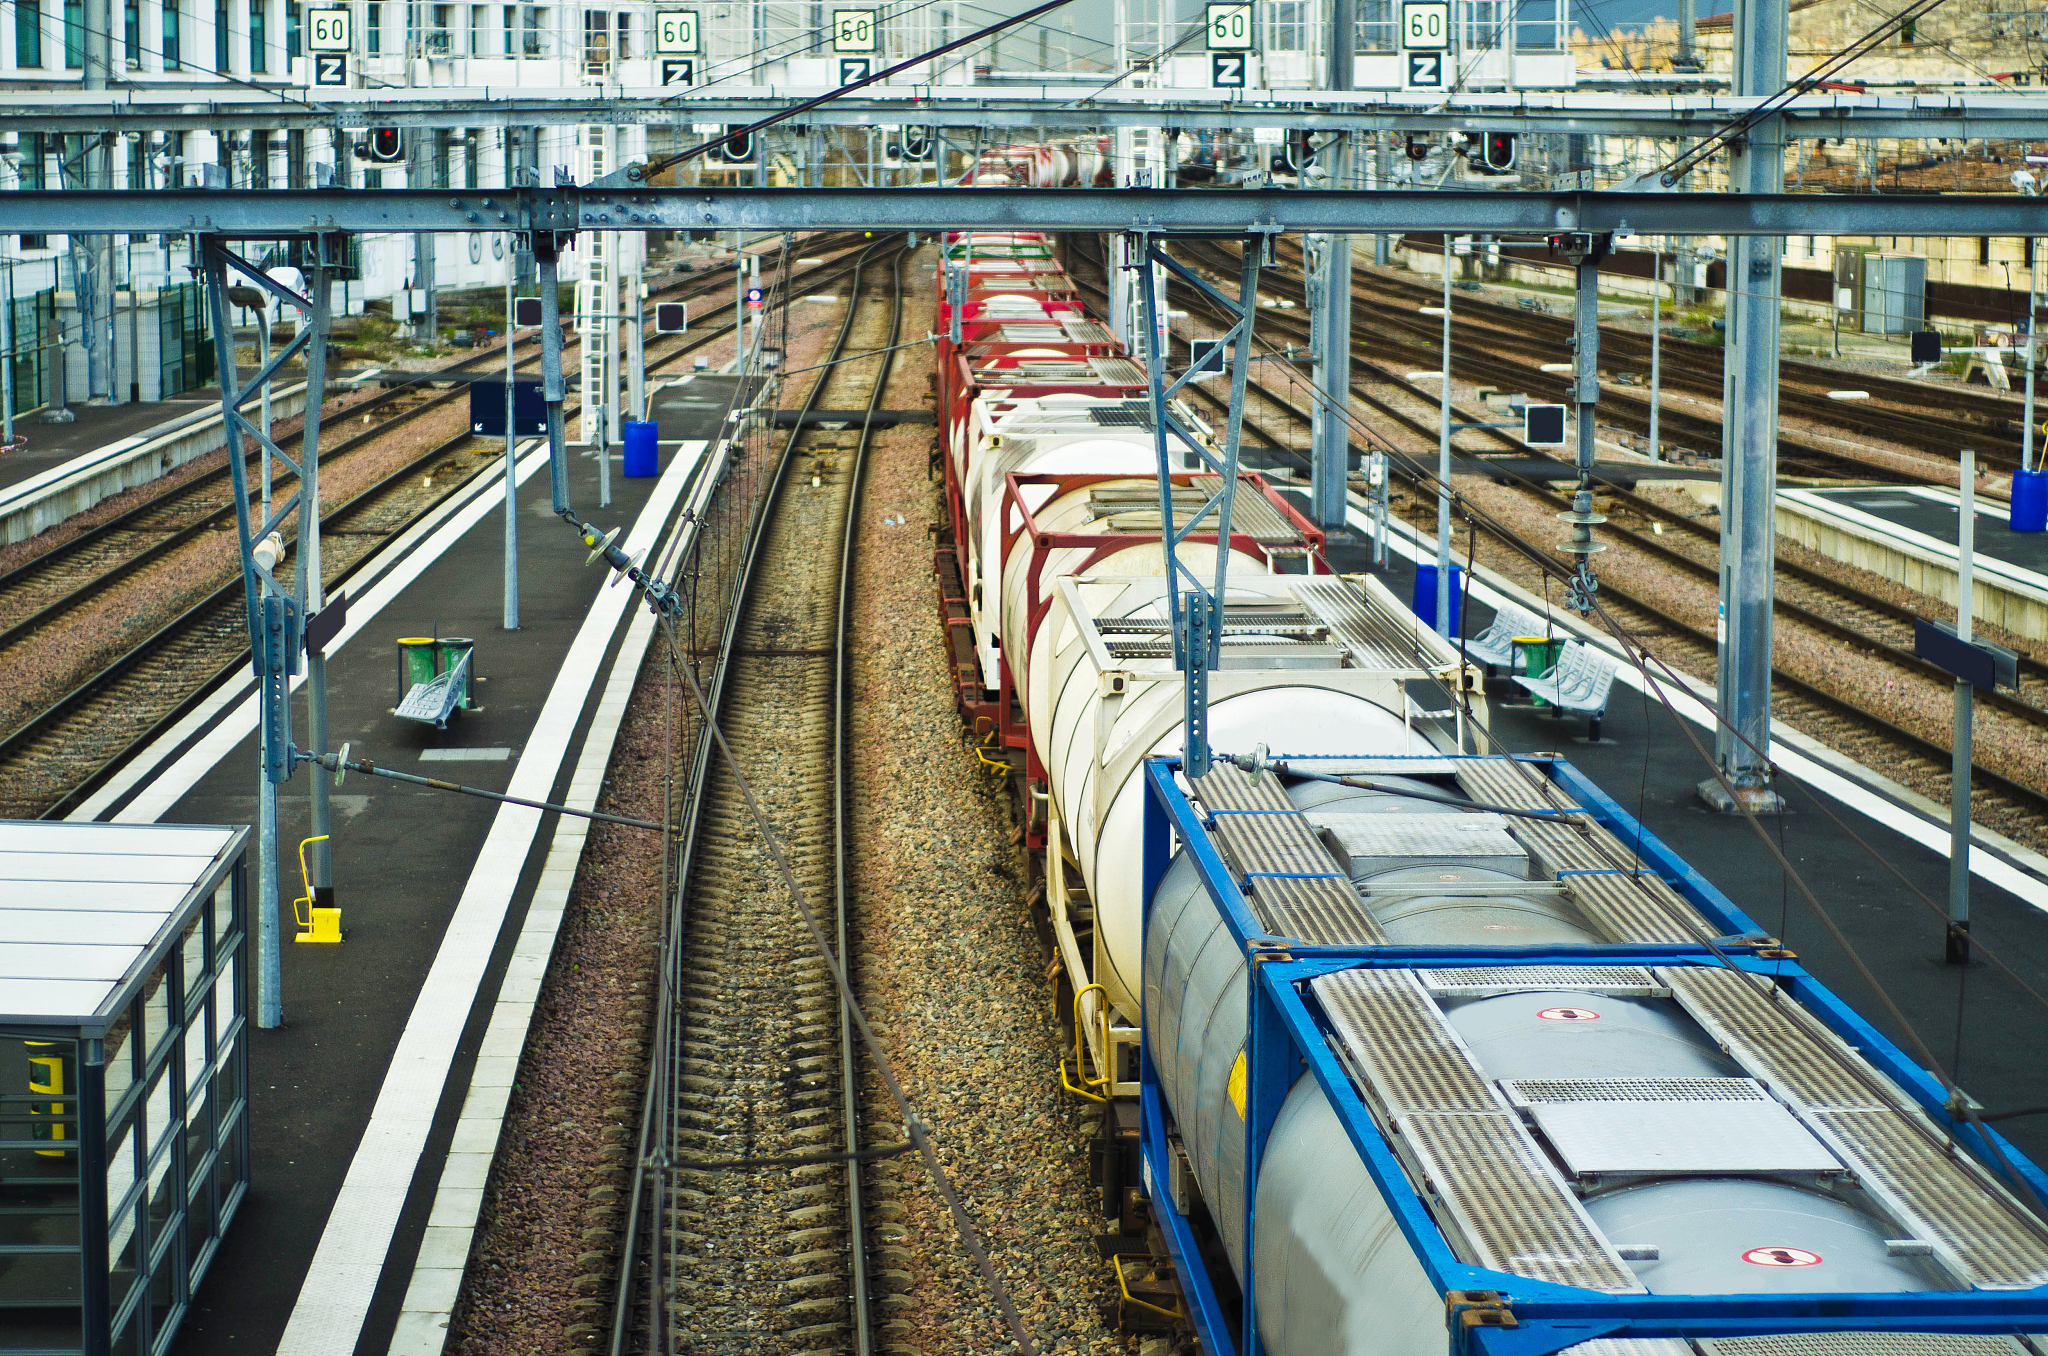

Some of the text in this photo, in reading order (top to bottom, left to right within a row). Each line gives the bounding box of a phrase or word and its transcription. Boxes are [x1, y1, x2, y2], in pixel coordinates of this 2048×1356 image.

[317, 18, 343, 40] 60
[665, 21, 690, 43] 60
[842, 20, 868, 41] 60
[1216, 14, 1244, 38] 60
[1412, 13, 1440, 37] 60
[321, 58, 342, 82] Z
[667, 63, 689, 86] Z
[844, 62, 866, 86] Z
[1217, 58, 1241, 83] Z
[1413, 57, 1437, 82] Z
